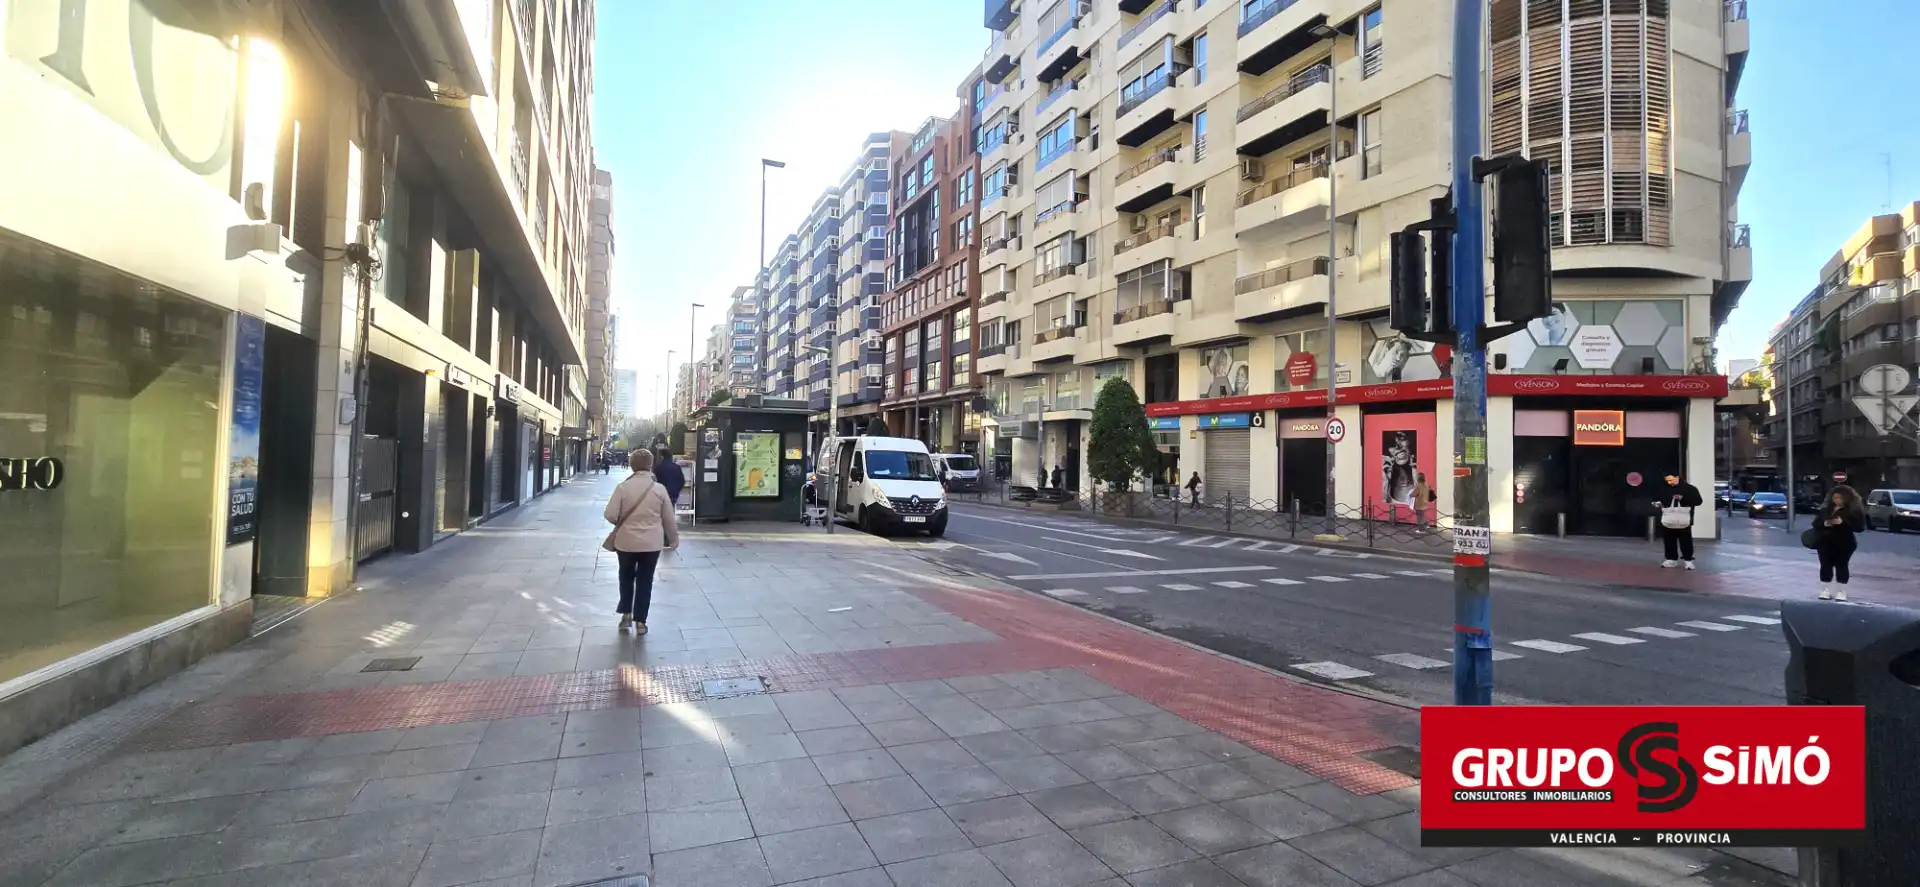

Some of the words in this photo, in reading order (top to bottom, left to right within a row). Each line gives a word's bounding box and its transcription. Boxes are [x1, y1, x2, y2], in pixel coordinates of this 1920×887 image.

[1519, 379, 1556, 389] SVENSON
[1667, 380, 1706, 390] SVENSON
[1292, 424, 1319, 432] PANDORA
[1329, 426, 1341, 434] 20
[1576, 423, 1622, 432] PANDORA
[231, 493, 246, 505] CON
[246, 491, 254, 503] TU
[231, 502, 254, 517] SALUD
